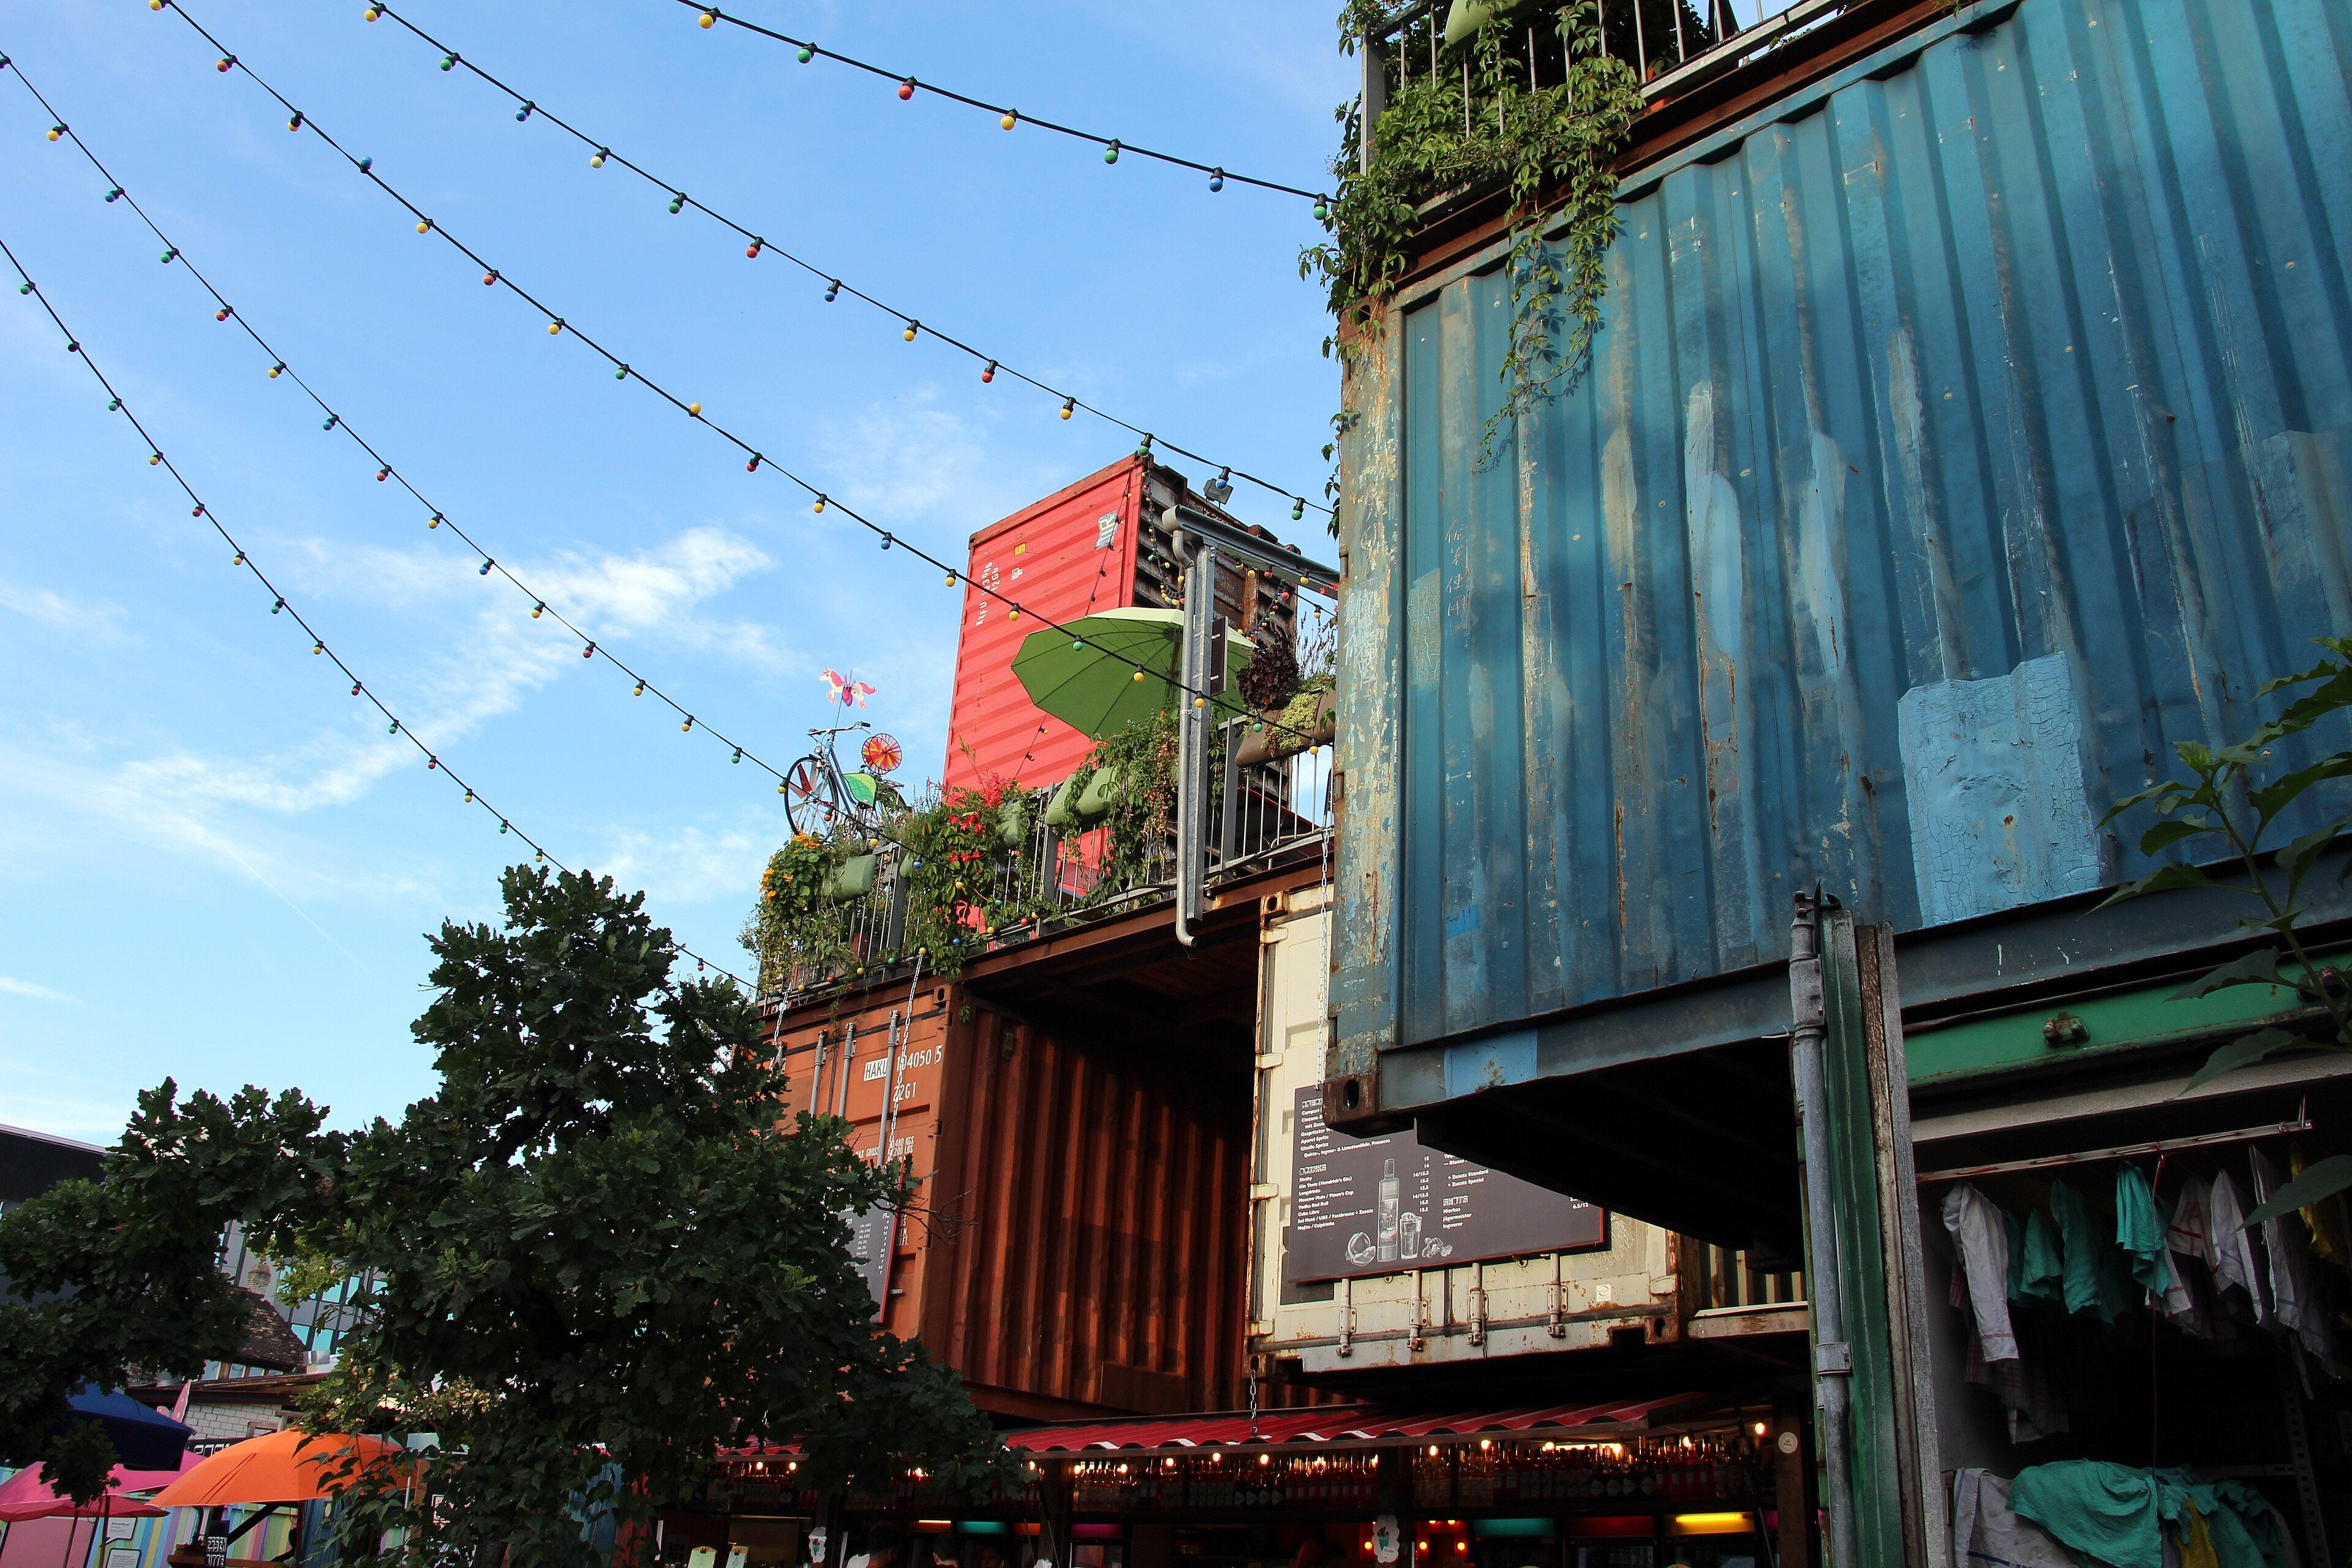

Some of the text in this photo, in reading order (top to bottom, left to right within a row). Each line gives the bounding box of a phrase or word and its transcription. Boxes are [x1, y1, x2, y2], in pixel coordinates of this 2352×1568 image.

[936, 1045, 941, 1063] 5
[905, 1136, 914, 1145] KGS
[904, 1145, 913, 1155] LBS
[1299, 1164, 1327, 1175] DRINKS
[1443, 1196, 1468, 1206] SHOTS
[1442, 1213, 1472, 1223] Jägermeister
